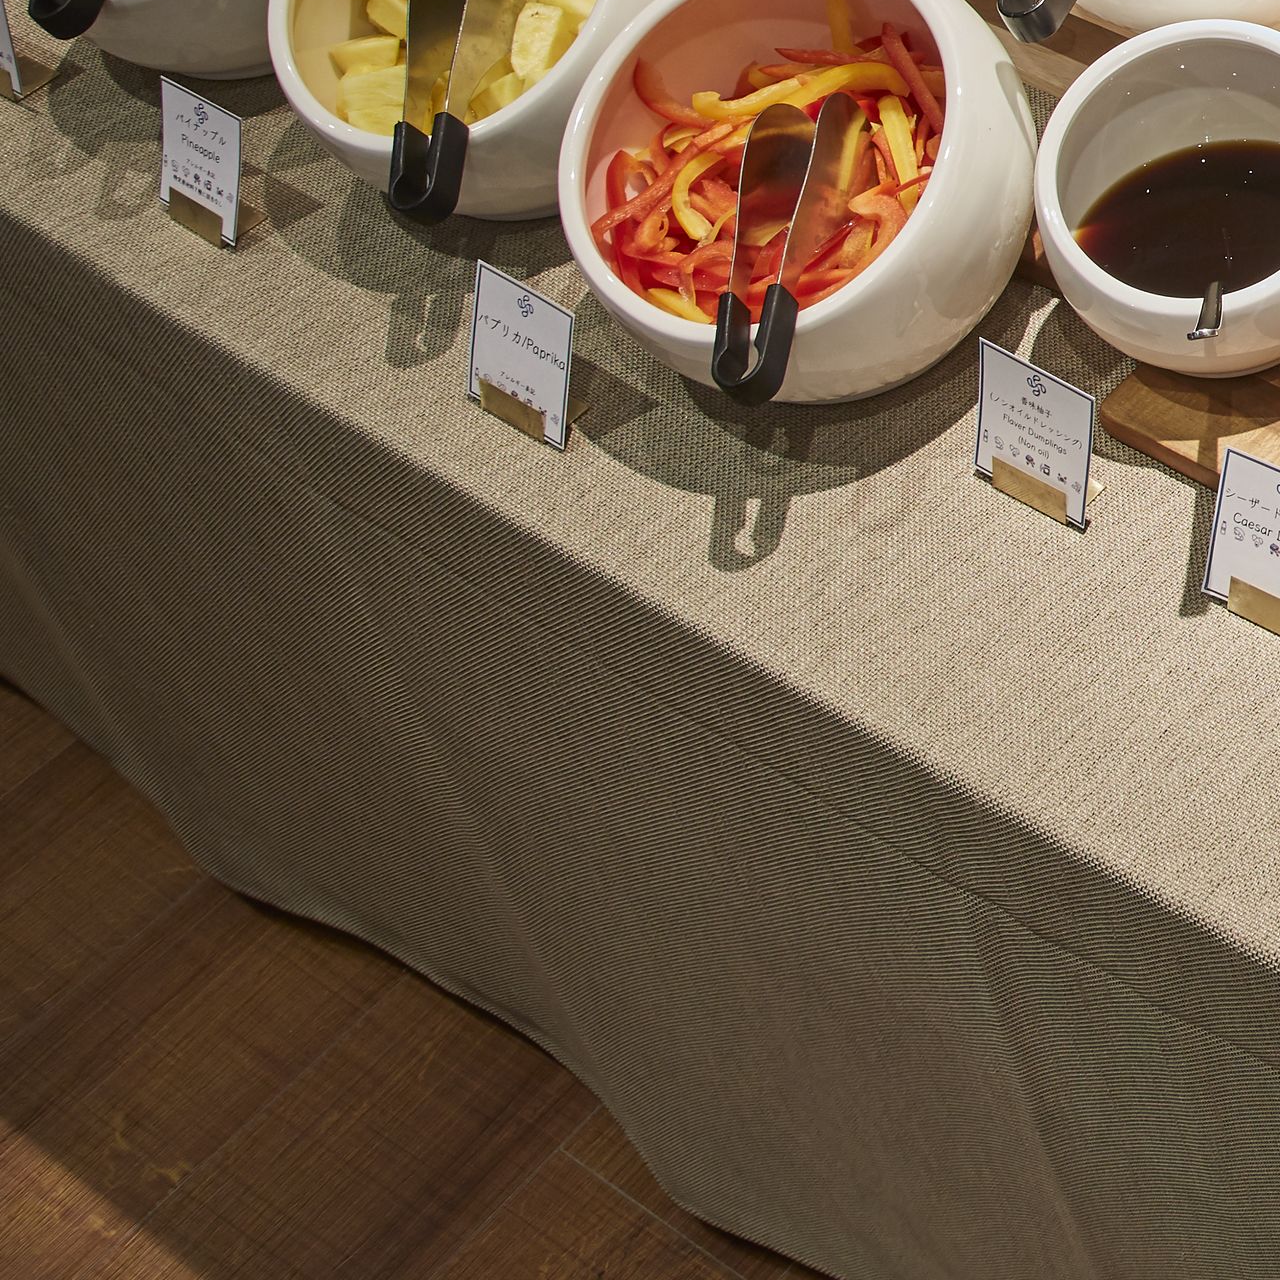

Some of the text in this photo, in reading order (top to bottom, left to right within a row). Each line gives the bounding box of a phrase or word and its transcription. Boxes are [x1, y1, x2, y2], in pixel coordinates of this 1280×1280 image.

[175, 114, 227, 147] パイナップル
[180, 133, 221, 165] Pineapple
[1018, 436, 1050, 460] (Non oil)
[1028, 427, 1067, 455] Dumplings
[1233, 512, 1274, 537] Caesar
